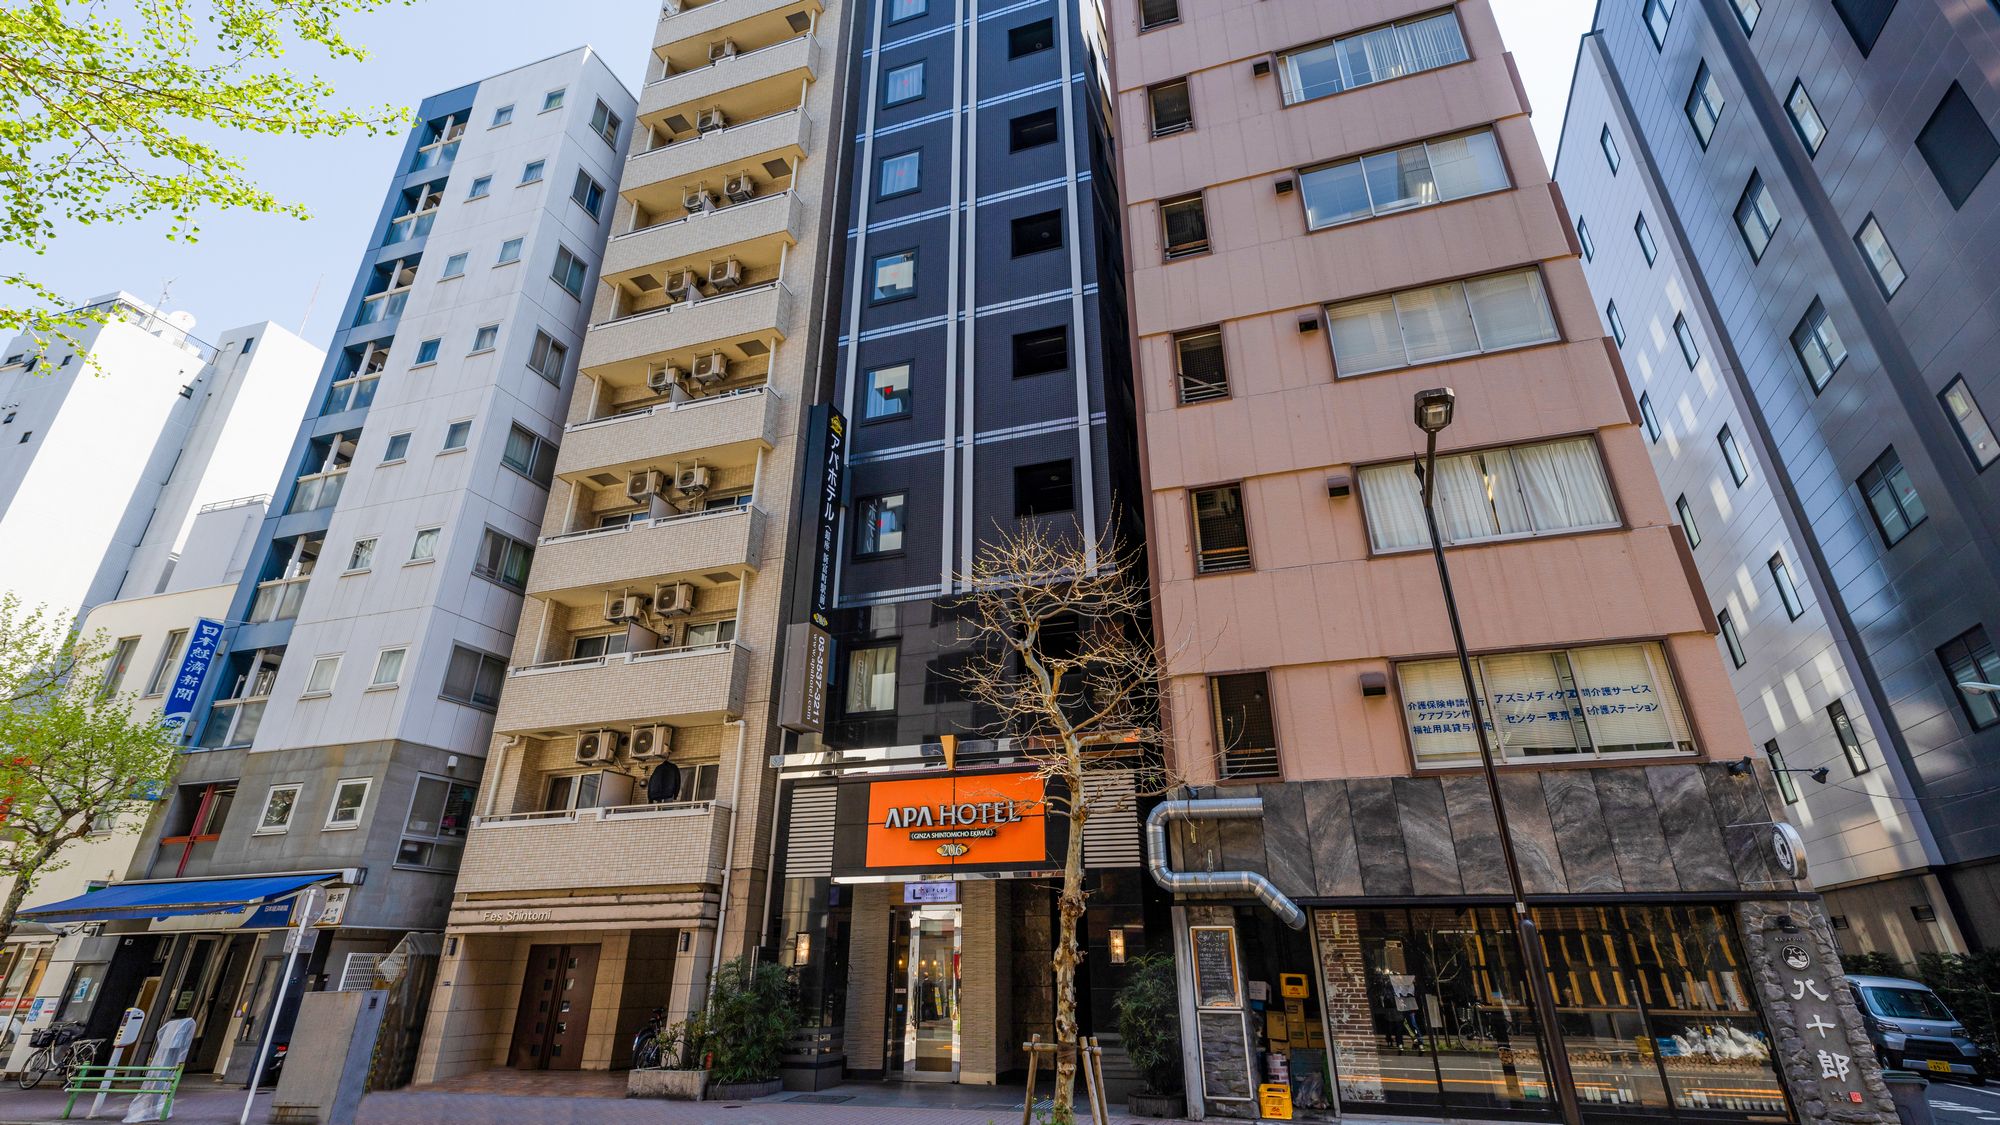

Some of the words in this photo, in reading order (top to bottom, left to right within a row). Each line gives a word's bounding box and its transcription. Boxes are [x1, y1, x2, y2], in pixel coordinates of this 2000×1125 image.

[824, 433, 840, 521] アパホテル
[175, 624, 219, 701] 日本経済新聞
[806, 633, 818, 720] www.apahotel.com
[812, 636, 825, 725] 03-3537-3211
[884, 806, 933, 828] APA
[939, 800, 1022, 826] HOTEL
[931, 830, 969, 839] SHINTOMICHO
[483, 911, 502, 922] Fes
[505, 909, 552, 921] Shintomi
[1791, 978, 1850, 1082] 八十郎
